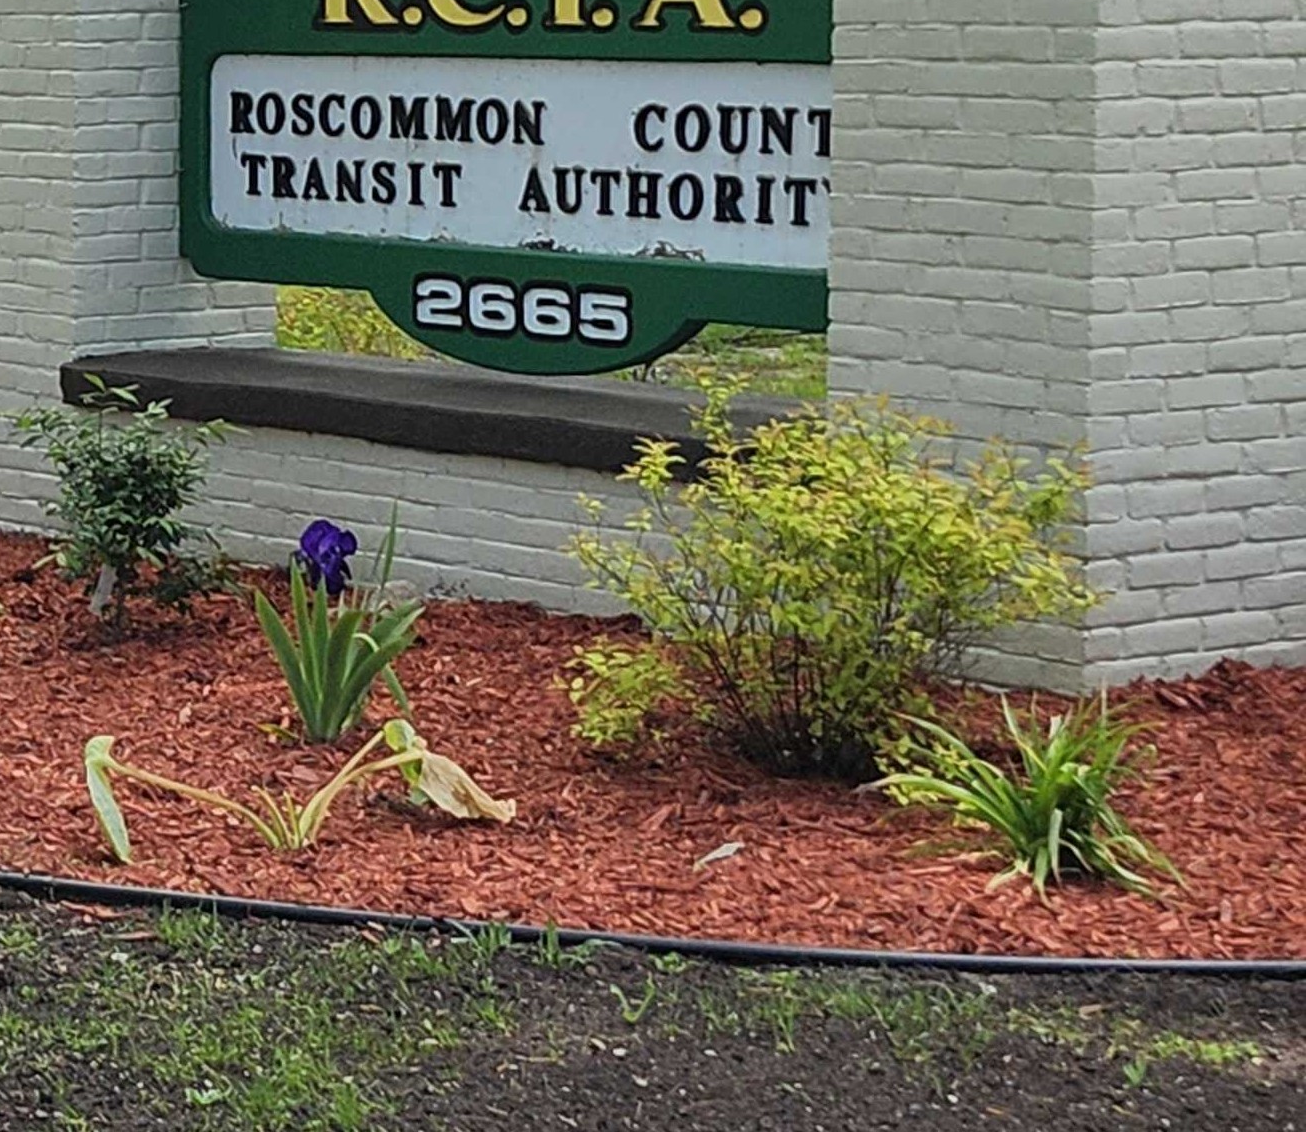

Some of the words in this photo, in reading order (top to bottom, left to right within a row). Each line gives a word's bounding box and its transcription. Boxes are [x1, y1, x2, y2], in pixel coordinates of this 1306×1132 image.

[229, 91, 547, 145] ROSCOMMON
[633, 103, 832, 157] COUNT
[240, 153, 462, 208] TRANSIT
[519, 167, 832, 226] AUTHORIT
[415, 278, 629, 342] 2665
